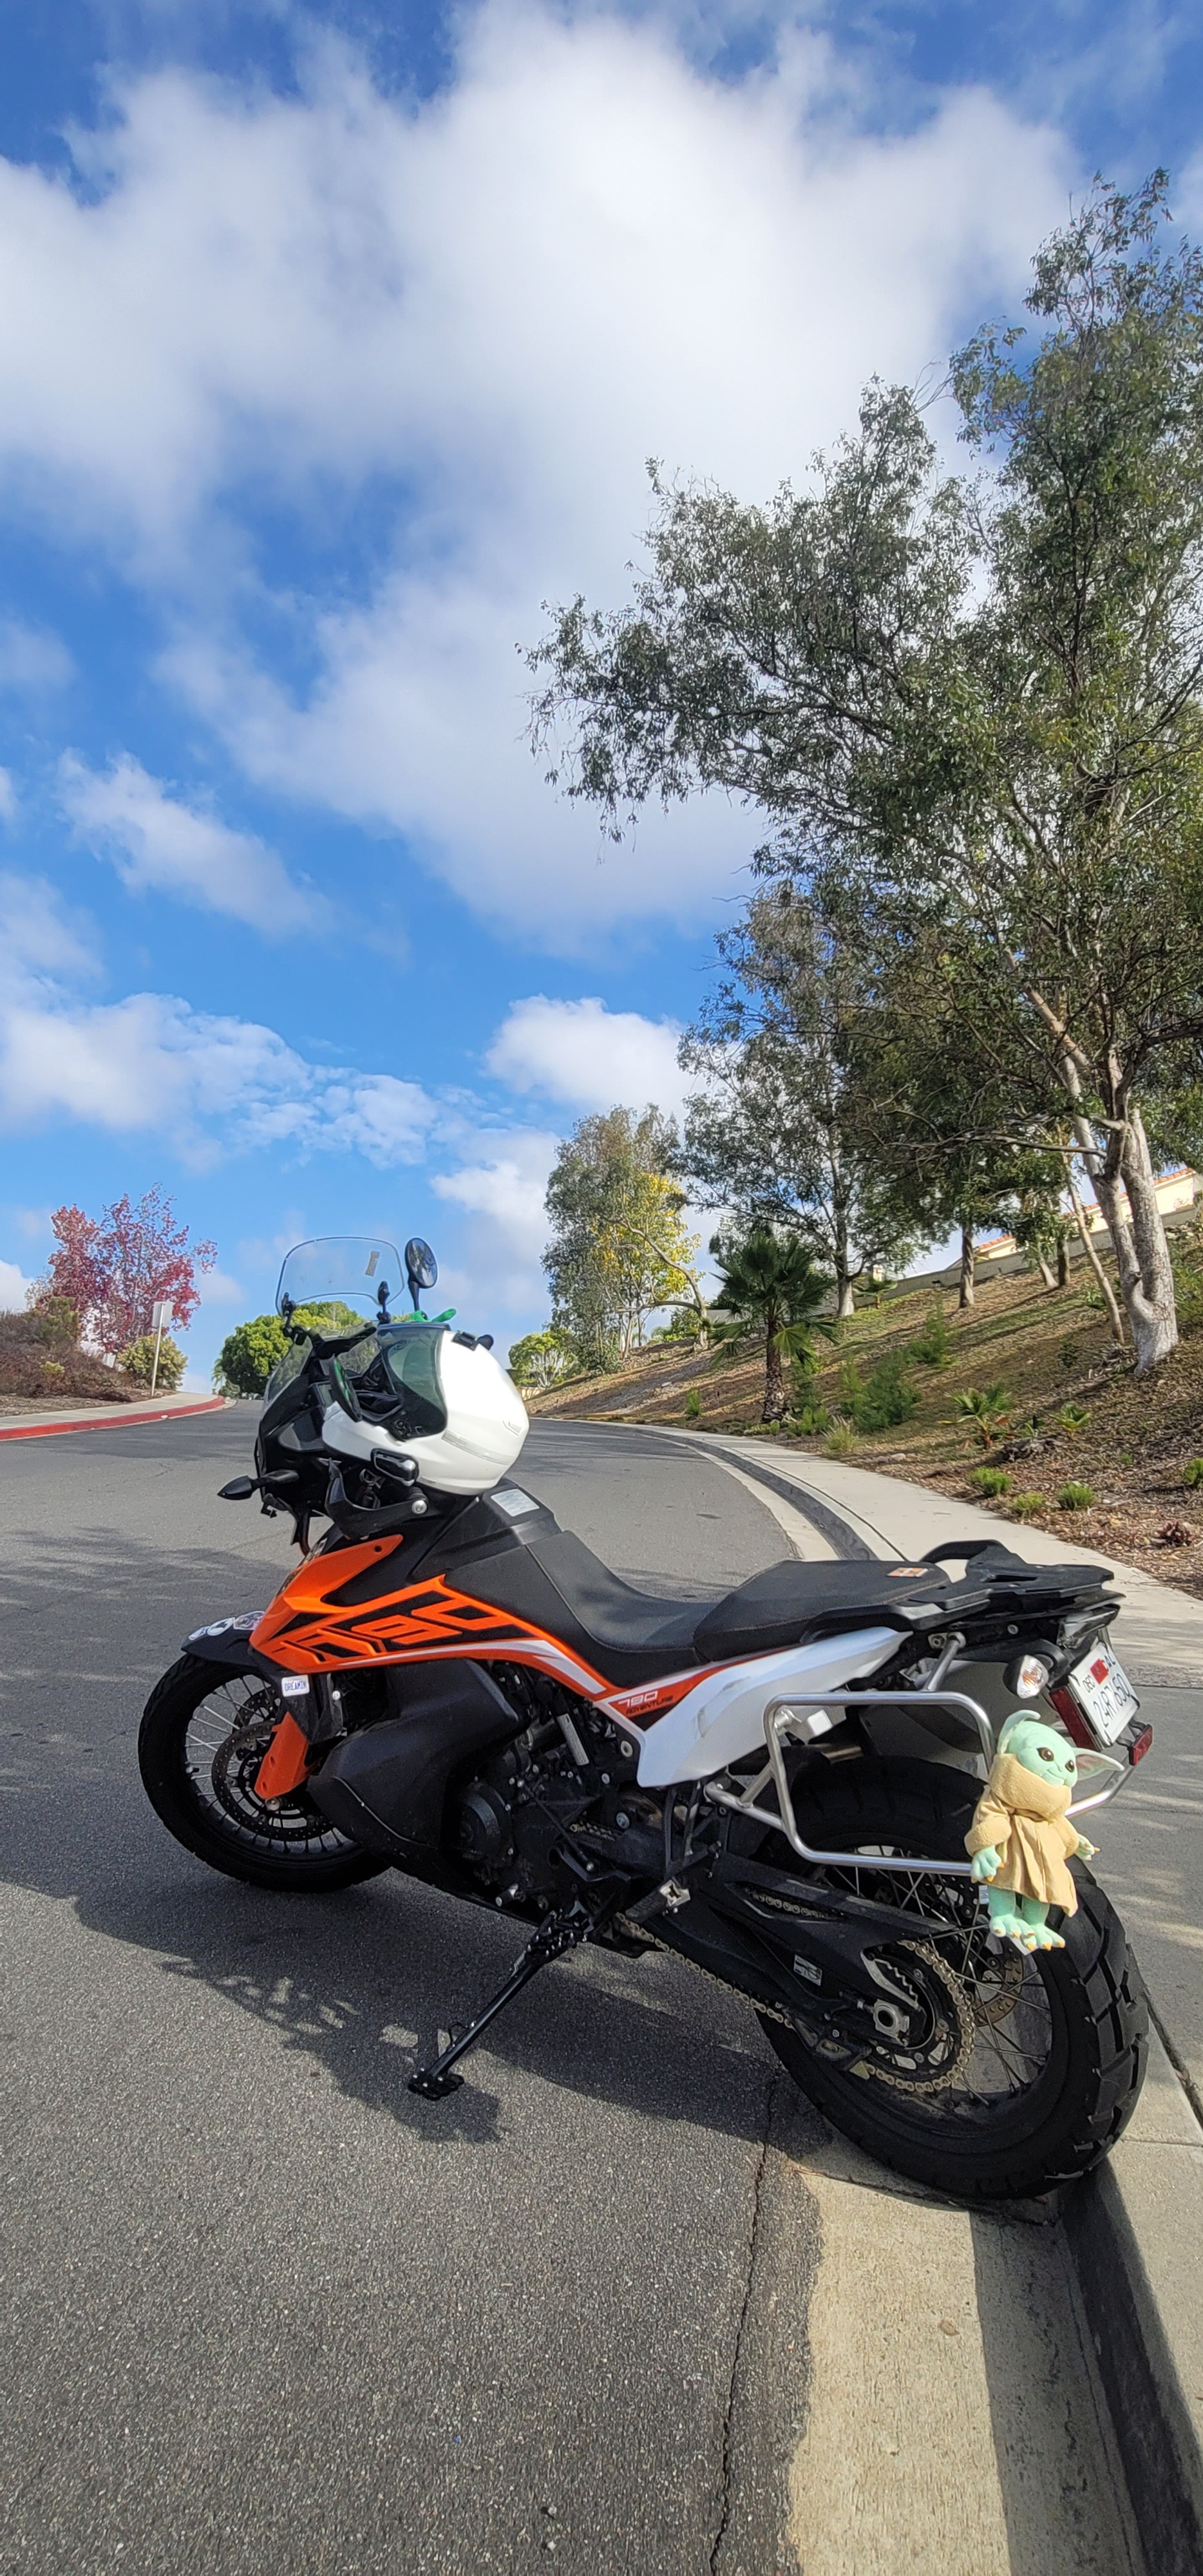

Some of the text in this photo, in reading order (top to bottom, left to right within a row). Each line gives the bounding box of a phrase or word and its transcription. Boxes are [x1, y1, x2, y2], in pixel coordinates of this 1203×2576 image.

[1082, 1674, 1095, 1693] DEC
[618, 1690, 658, 1707] 790
[1093, 1673, 1131, 1728] 24R7650
